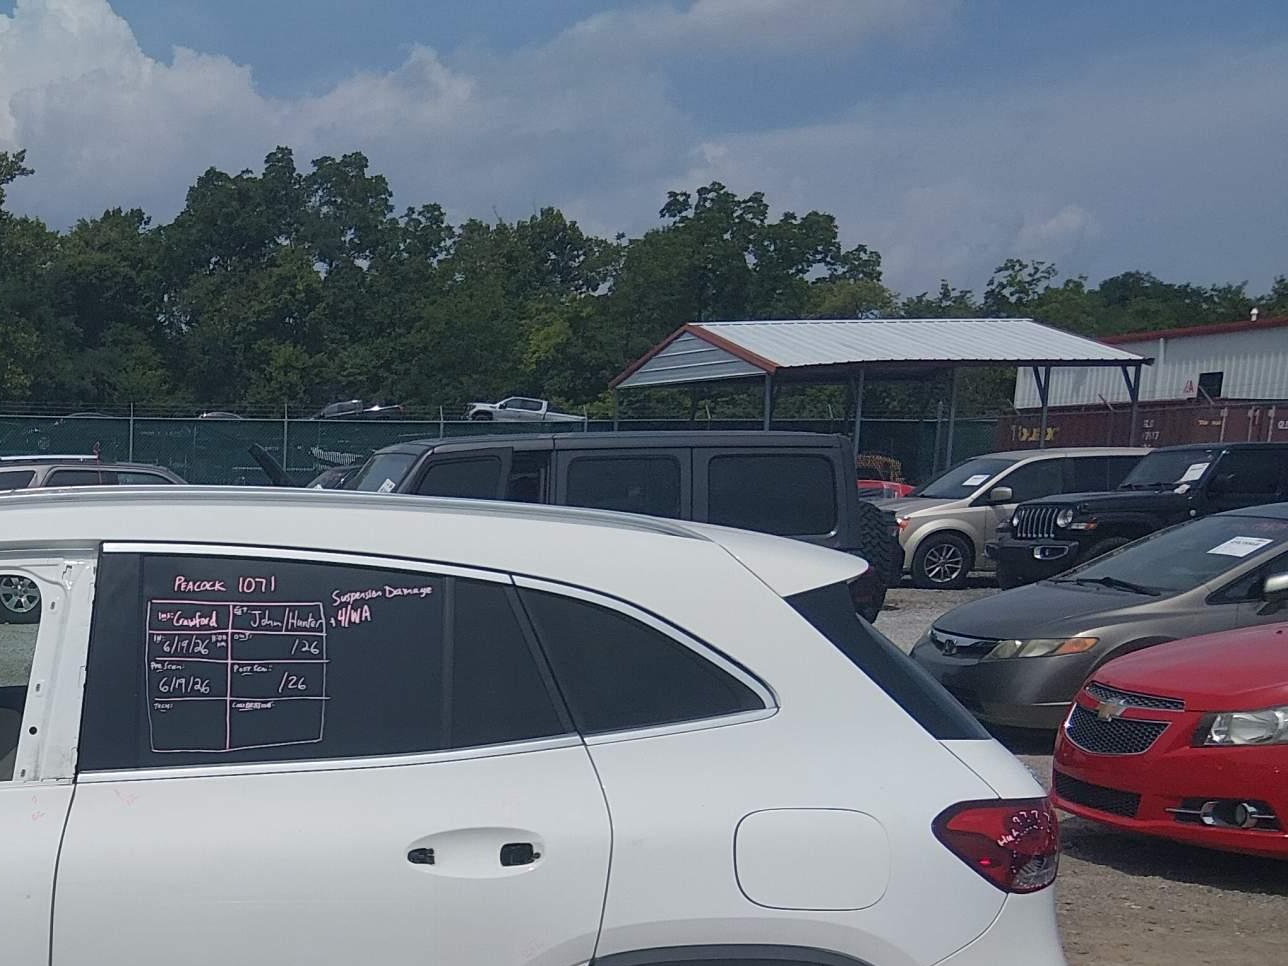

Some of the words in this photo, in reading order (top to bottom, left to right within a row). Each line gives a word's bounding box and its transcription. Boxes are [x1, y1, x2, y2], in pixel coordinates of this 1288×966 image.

[238, 575, 275, 593] 1071
[383, 585, 432, 598] Damage
[173, 610, 218, 628] Crawford
[163, 635, 210, 655] 6/19/26
[292, 638, 320, 655] /26
[278, 671, 307, 693] /26
